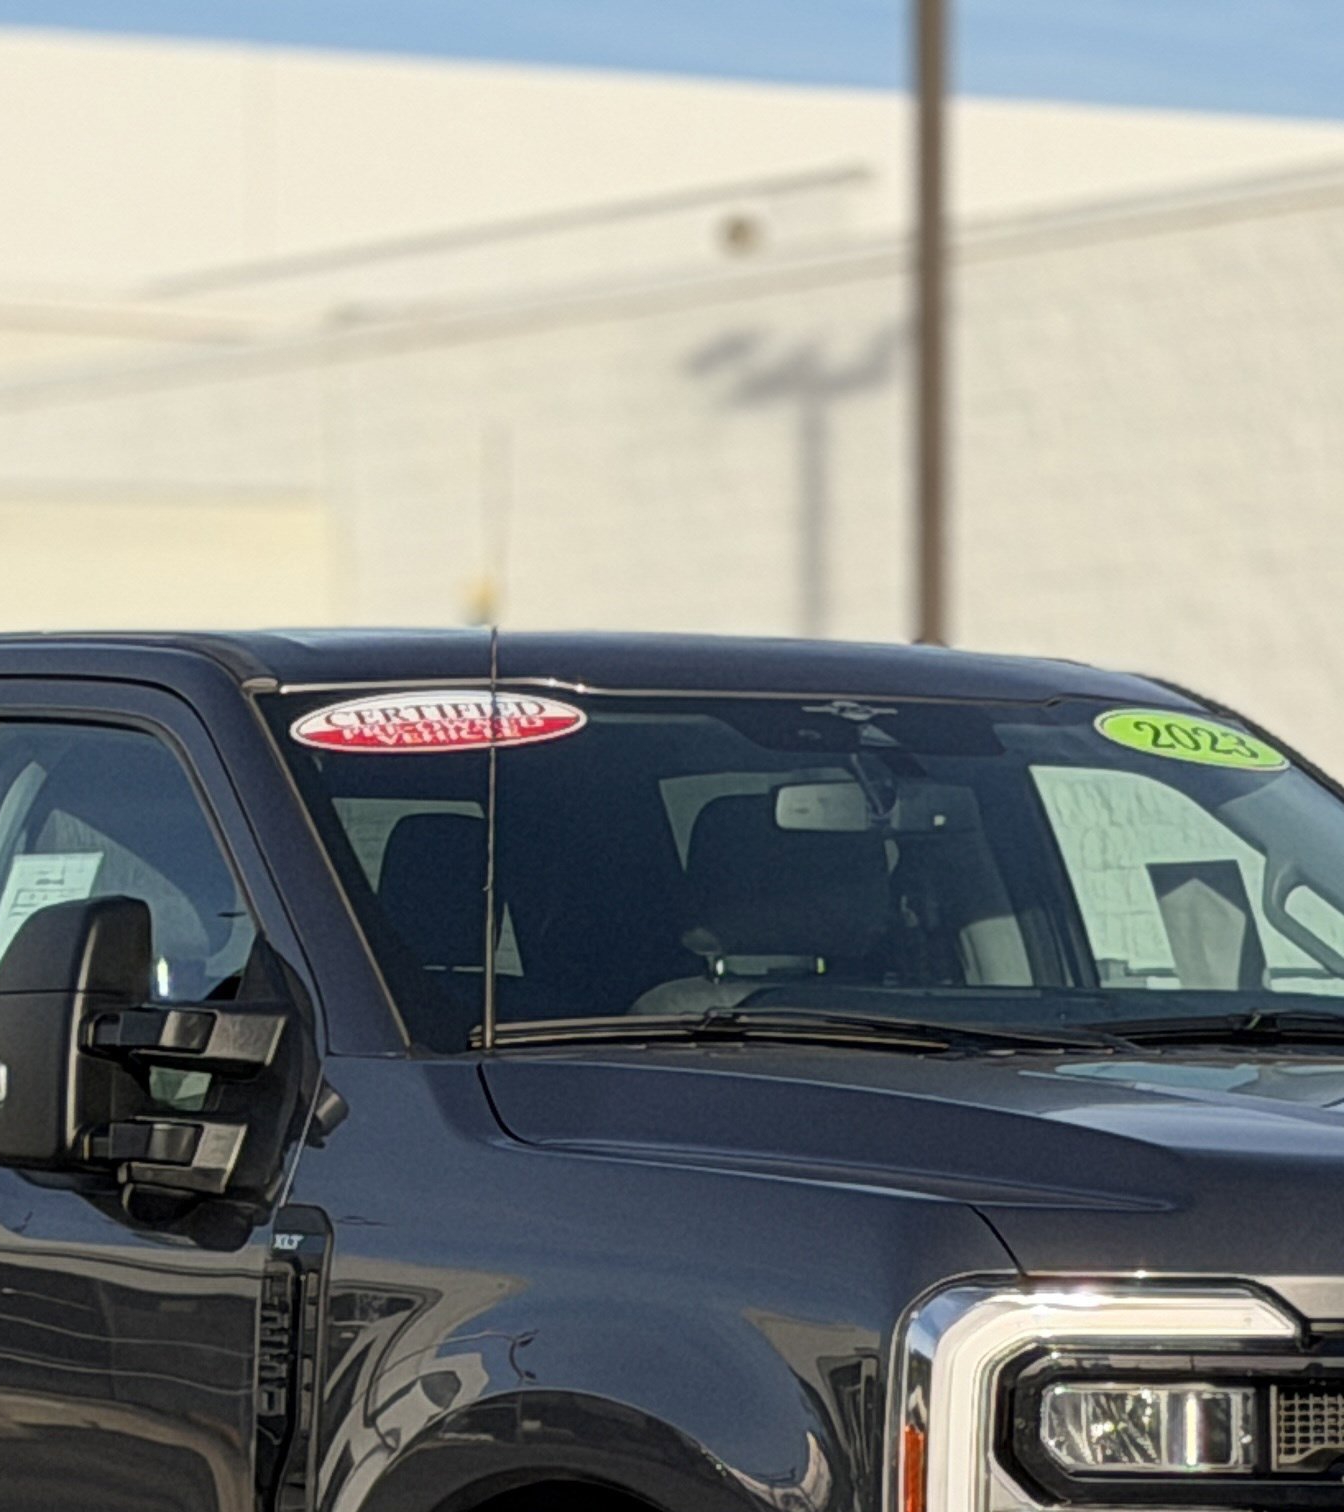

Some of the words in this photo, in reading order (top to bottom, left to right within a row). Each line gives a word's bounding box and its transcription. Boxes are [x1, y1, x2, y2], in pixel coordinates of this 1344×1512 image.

[325, 700, 545, 728] CERTIFIED
[1133, 721, 1259, 759] 2023
[272, 1233, 305, 1250] XLT
